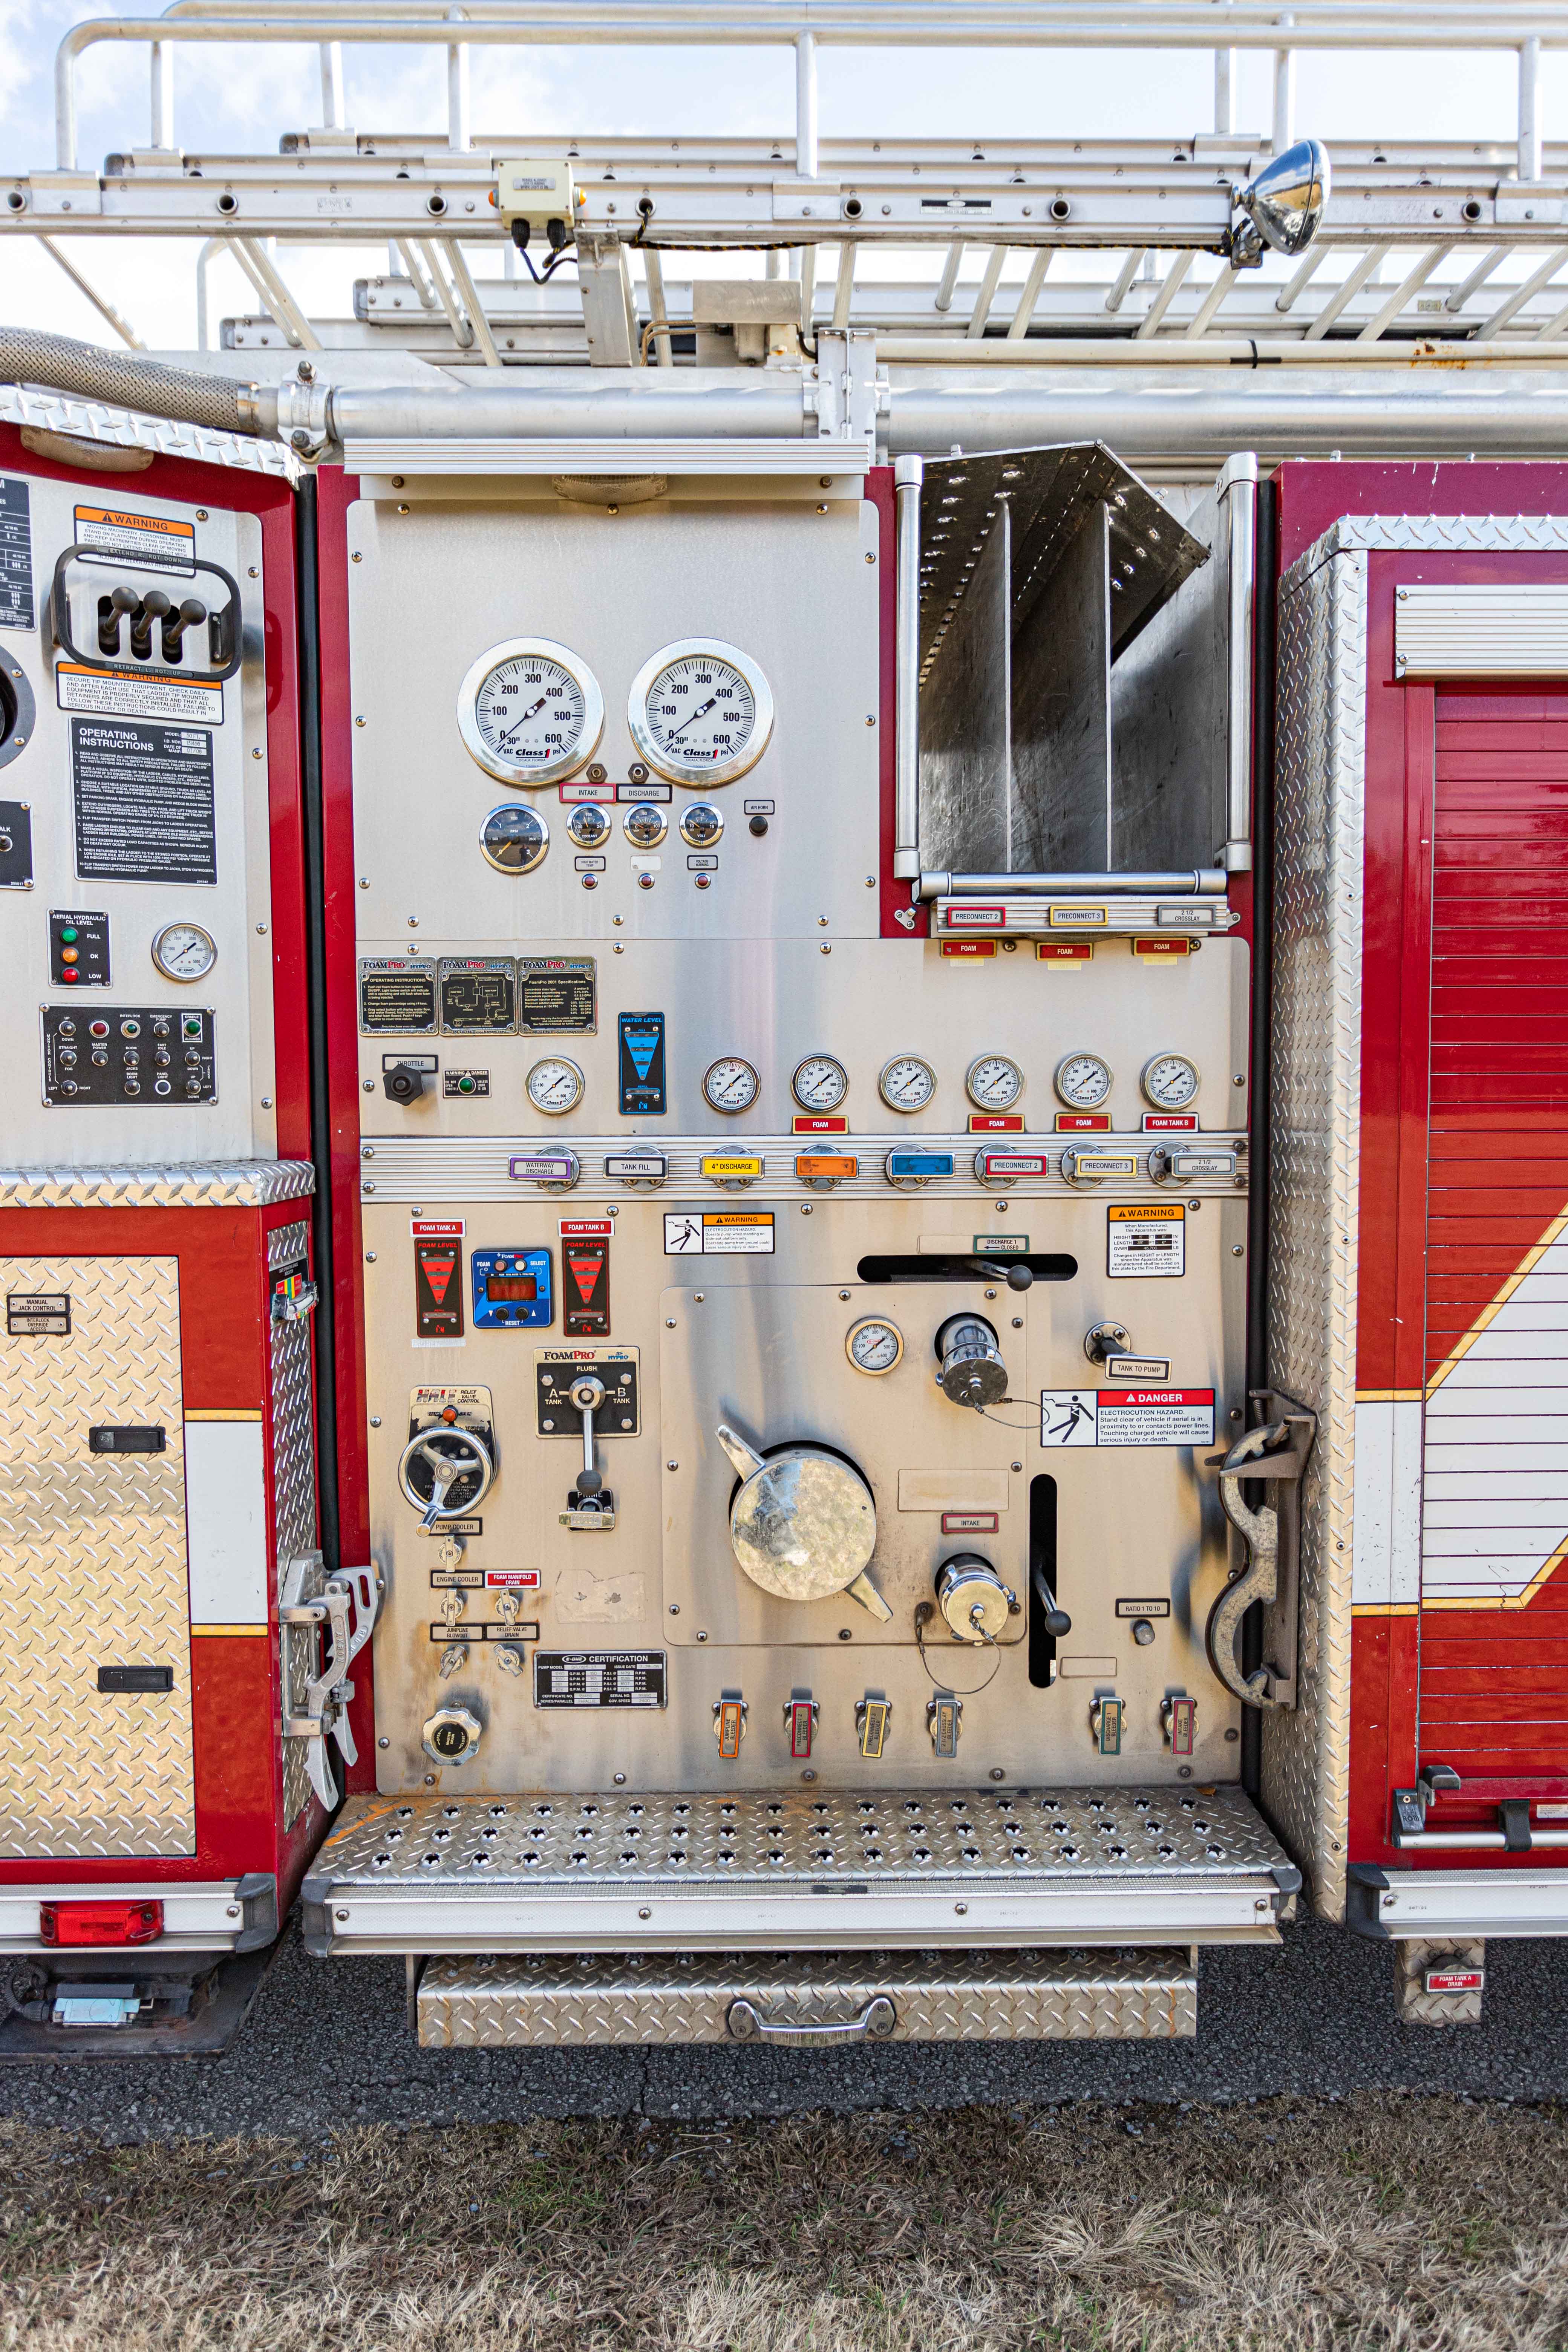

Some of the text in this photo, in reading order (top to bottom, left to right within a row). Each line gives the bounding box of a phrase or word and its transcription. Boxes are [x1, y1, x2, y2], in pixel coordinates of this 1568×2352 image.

[115, 515, 168, 531] WARNING
[525, 674, 541, 683] 300
[501, 685, 518, 694] 200
[546, 688, 563, 697] 400
[492, 706, 507, 715] 100
[554, 712, 571, 720] 500
[80, 728, 137, 741] OPERATING
[545, 734, 562, 743] 600
[80, 737, 154, 751] INSTRUCTIONS
[549, 1389, 558, 1398] A
[618, 1387, 626, 1396] B
[1138, 1394, 1182, 1402] DANGER
